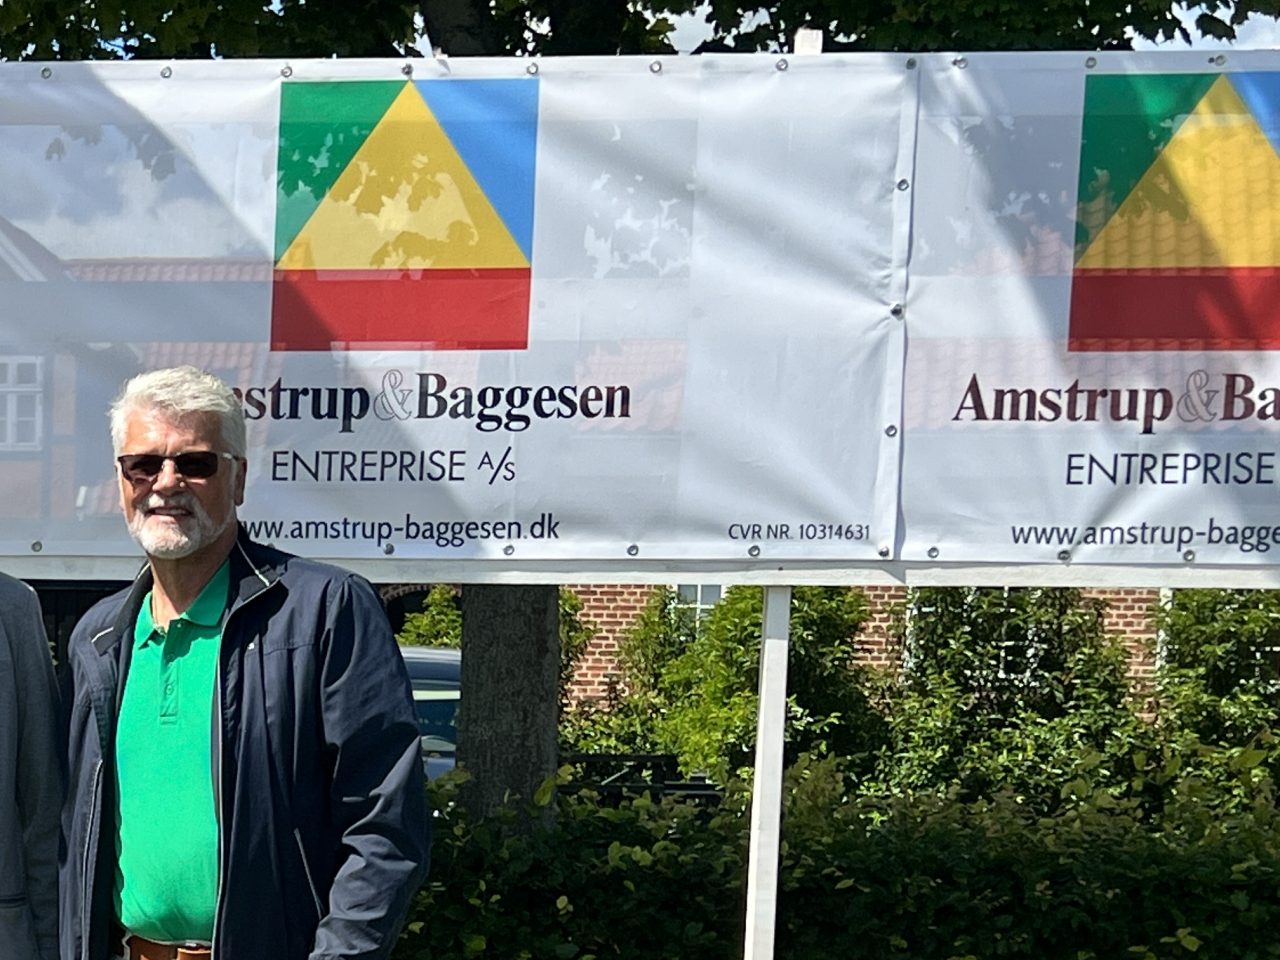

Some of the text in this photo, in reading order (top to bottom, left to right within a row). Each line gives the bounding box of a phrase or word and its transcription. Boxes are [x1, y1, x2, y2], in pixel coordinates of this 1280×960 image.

[231, 368, 632, 434] strup&Baggesen
[270, 449, 467, 483] ENTREPRISE
[1065, 452, 1276, 485] ENTREPRISE
[241, 512, 561, 547] ww.amstrup-baggesen.dk
[728, 523, 762, 540] CVR
[799, 523, 871, 541] 10314631
